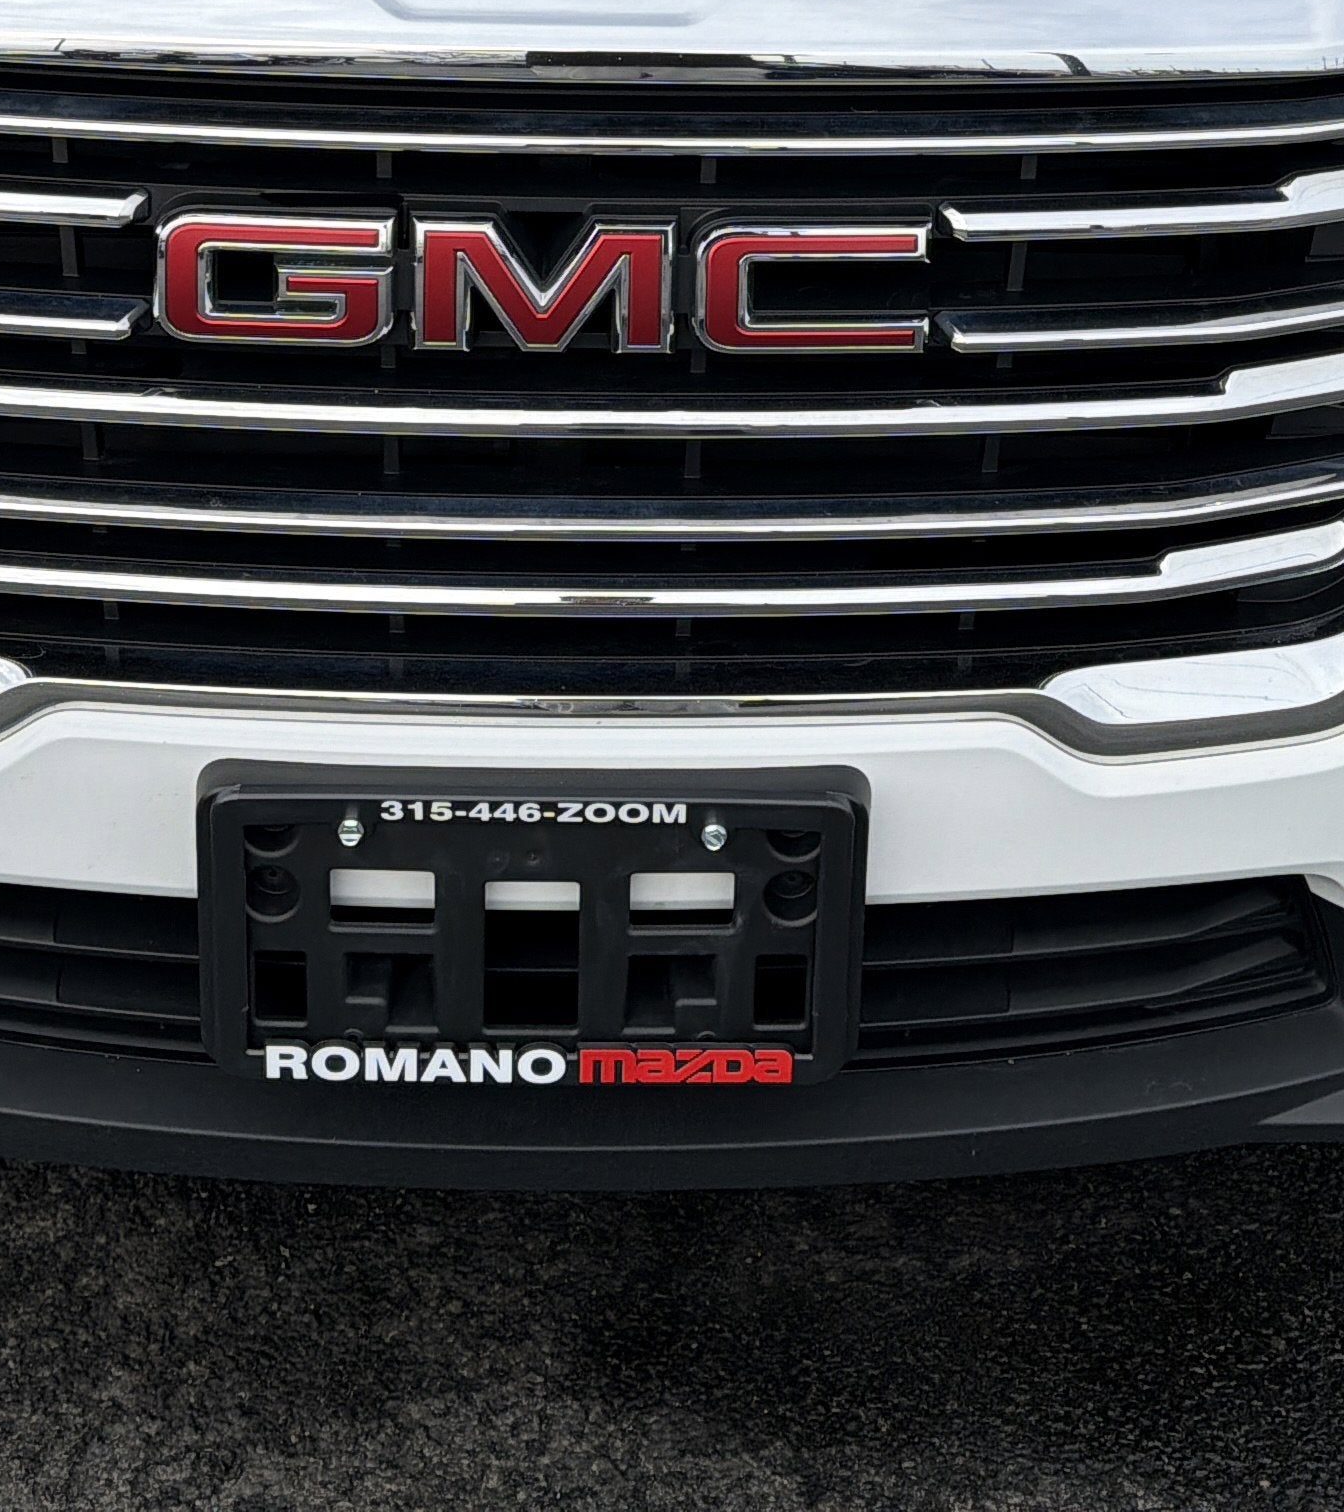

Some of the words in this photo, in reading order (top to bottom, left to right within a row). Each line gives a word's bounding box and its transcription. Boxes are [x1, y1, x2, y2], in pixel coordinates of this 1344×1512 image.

[155, 212, 932, 354] GMC
[379, 800, 688, 825] 315-446-ZOOM
[264, 1045, 567, 1085] ROMANO
